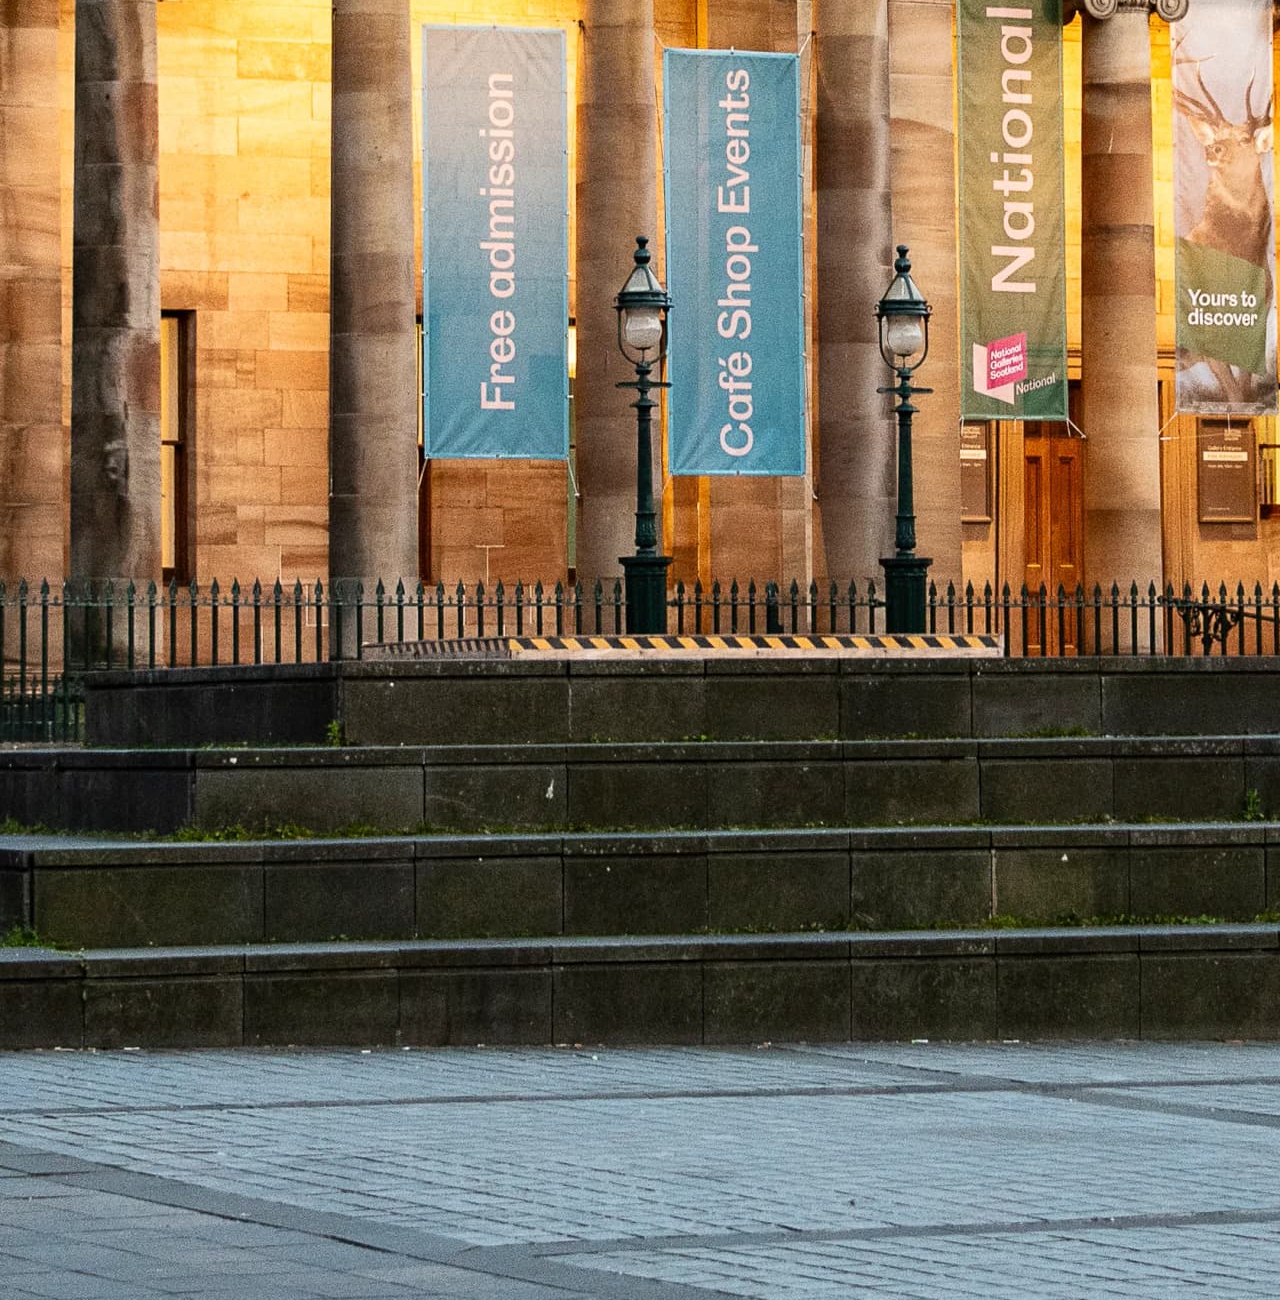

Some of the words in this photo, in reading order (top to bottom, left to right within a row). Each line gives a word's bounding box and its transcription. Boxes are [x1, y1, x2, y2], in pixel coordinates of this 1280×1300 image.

[717, 68, 751, 214] Events
[985, 6, 1037, 294] National
[479, 72, 516, 299] admission
[718, 226, 760, 340] Shop
[1187, 288, 1238, 307] Yours
[1240, 290, 1257, 308] to
[1187, 307, 1258, 327] discover
[480, 308, 516, 411] Free
[990, 342, 1022, 361] National
[990, 354, 1024, 371] Galleries
[990, 362, 1024, 381] Scotland
[1016, 371, 1056, 396] National
[718, 351, 754, 458] Café
